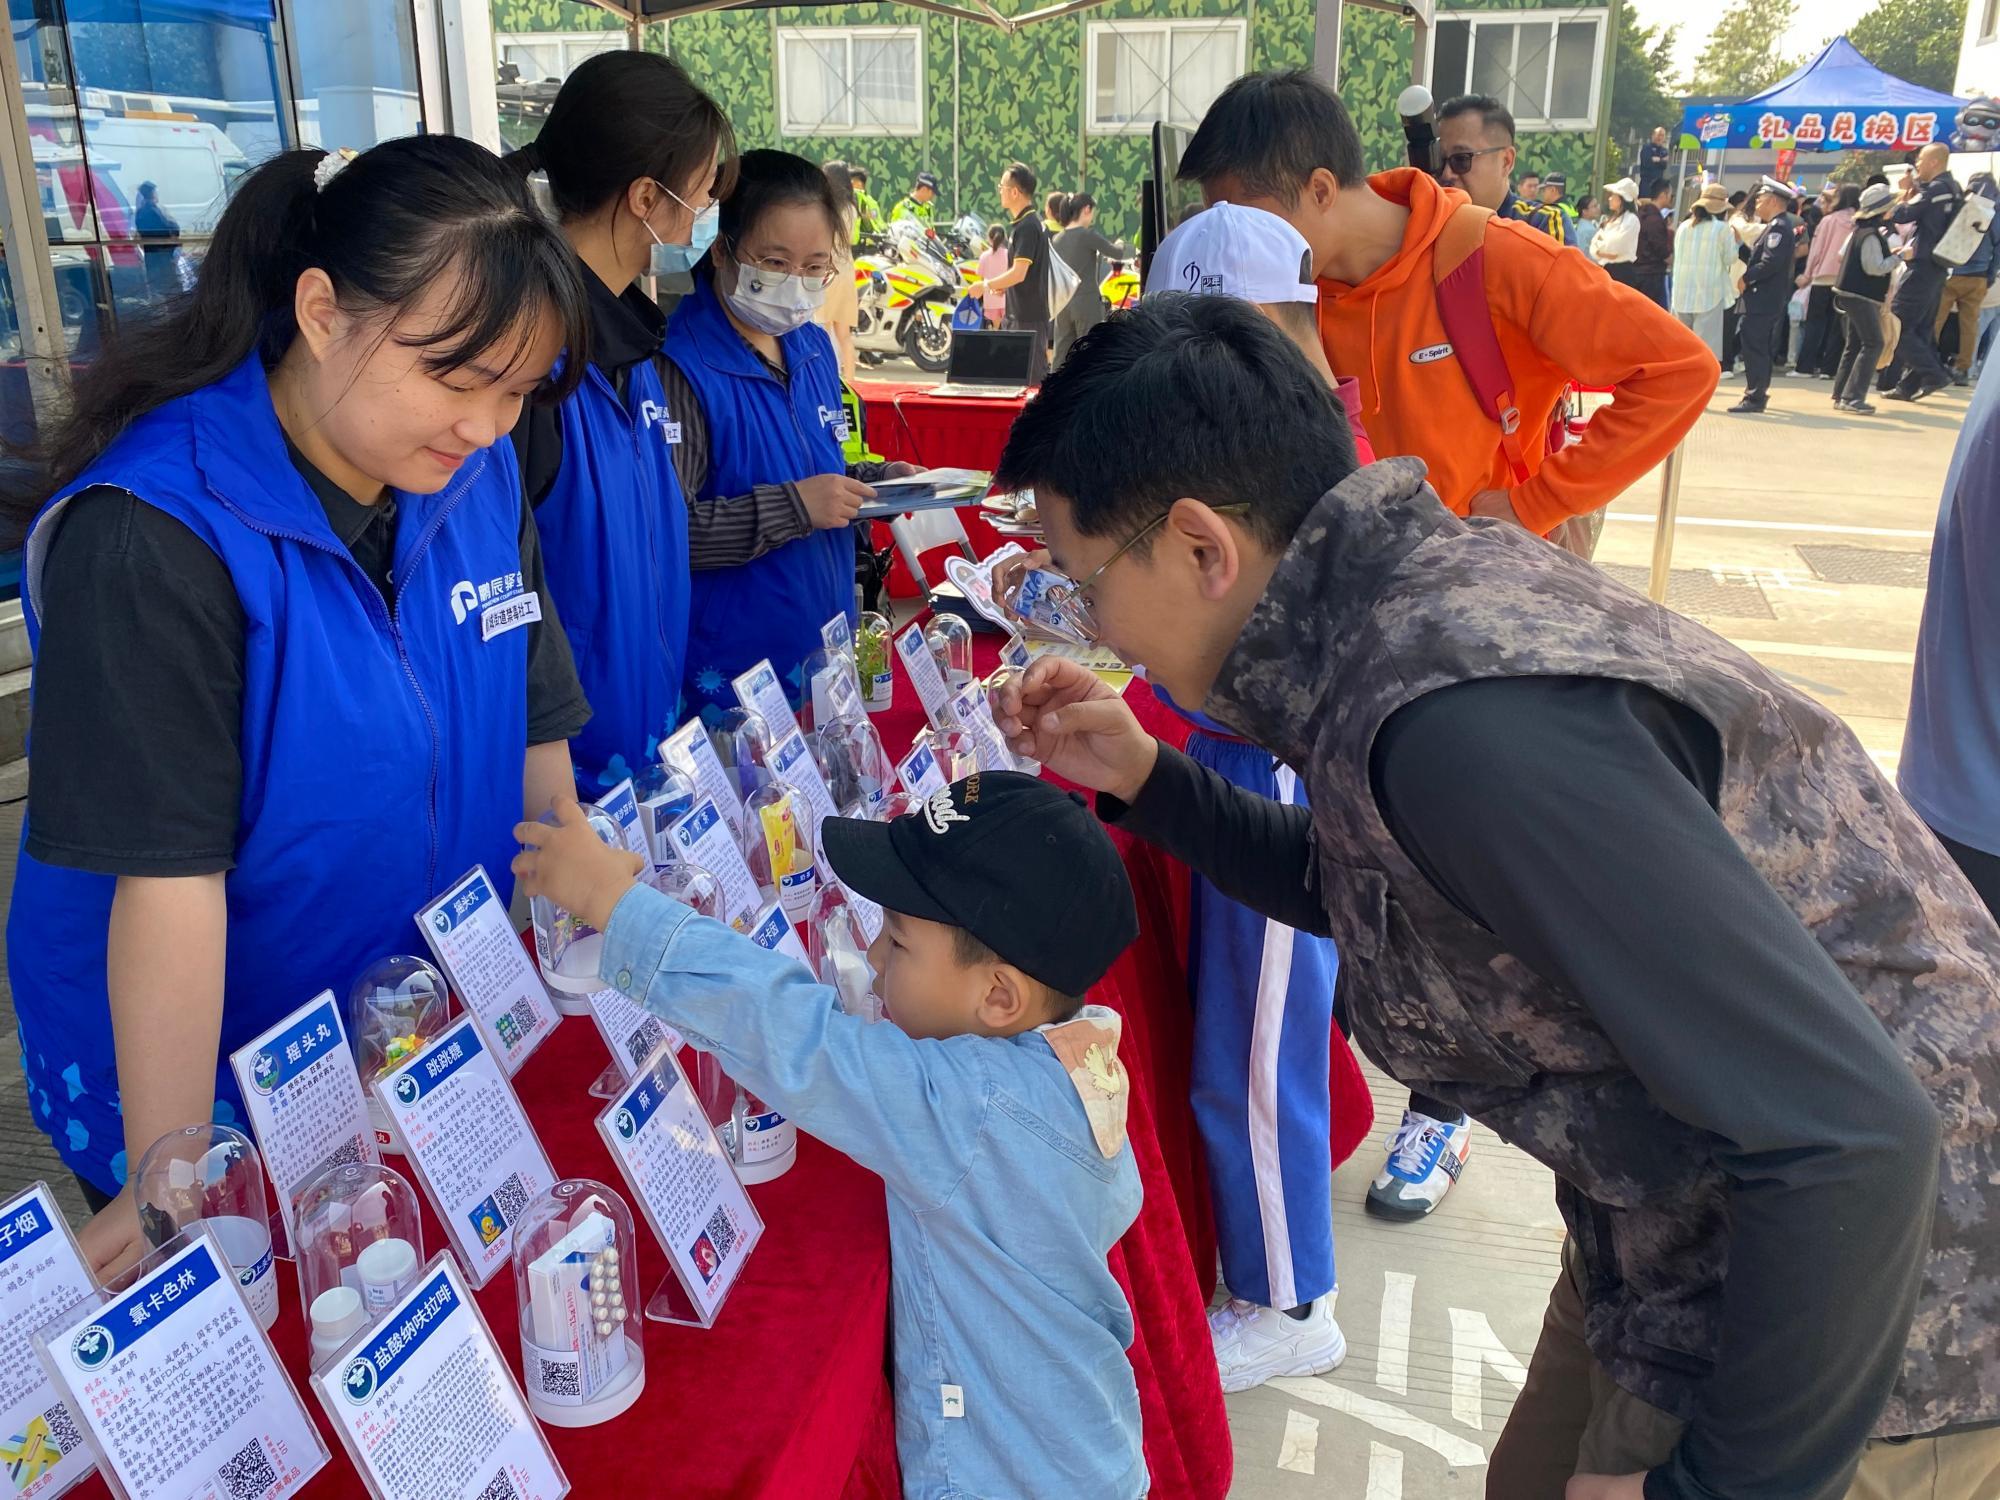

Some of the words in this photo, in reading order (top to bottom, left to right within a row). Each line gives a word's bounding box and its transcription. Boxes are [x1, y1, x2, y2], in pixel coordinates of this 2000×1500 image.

[1759, 112, 1936, 145] 礼品兑换区
[452, 888, 479, 916] 摇头丸
[758, 919, 780, 948] 可卡因
[284, 1018, 332, 1065] 摇头丸
[424, 1039, 463, 1079] 跳跳糖
[636, 1071, 665, 1111] 麻古
[126, 1266, 198, 1328] 氯卡色林
[372, 1281, 454, 1371] 盐酸纳呋拉啡
[83, 1349, 138, 1395] 别名：减肥药
[89, 1367, 136, 1407] 外观：片剂
[360, 1399, 398, 1441] 外观：片剂
